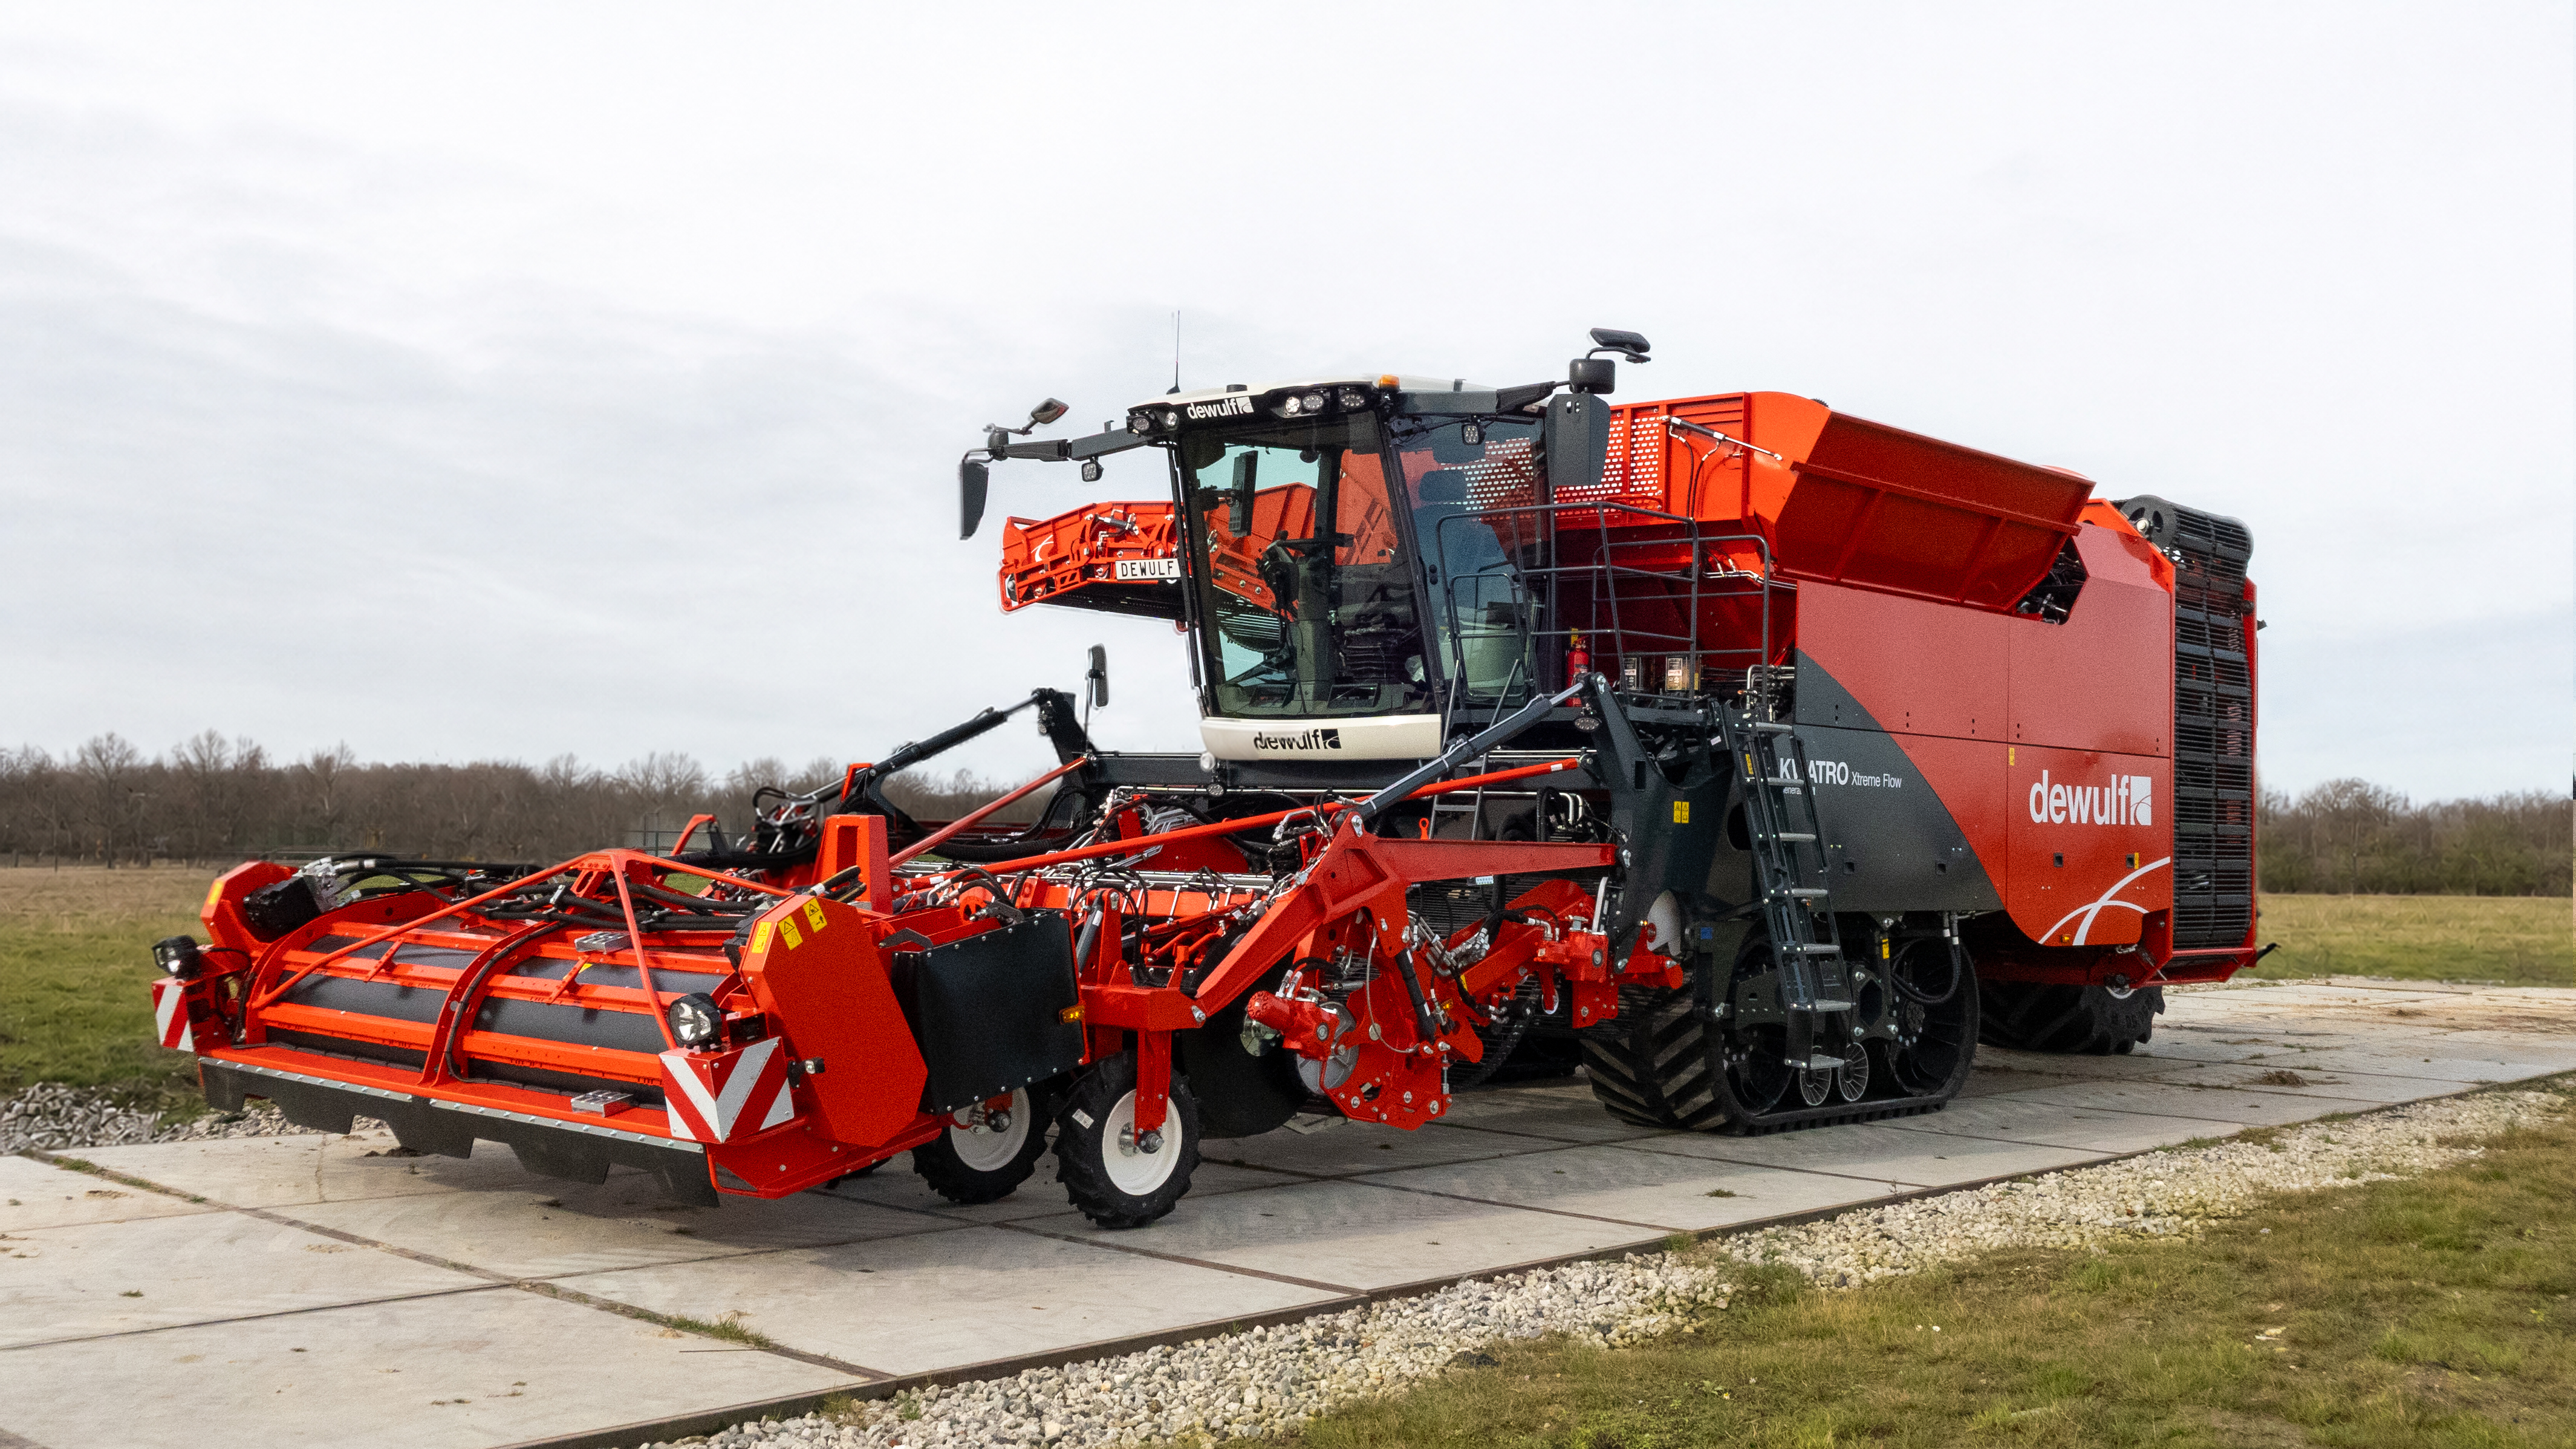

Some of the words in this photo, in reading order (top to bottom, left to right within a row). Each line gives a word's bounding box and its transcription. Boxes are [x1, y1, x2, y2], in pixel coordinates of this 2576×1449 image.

[1186, 398, 1238, 419] dewulf
[1120, 561, 1174, 577] DEWULF
[1254, 729, 1321, 750] dewulf
[1851, 771, 1881, 787] Xtreme
[1882, 773, 1902, 789] Flow
[2029, 769, 2129, 825] dewulf
